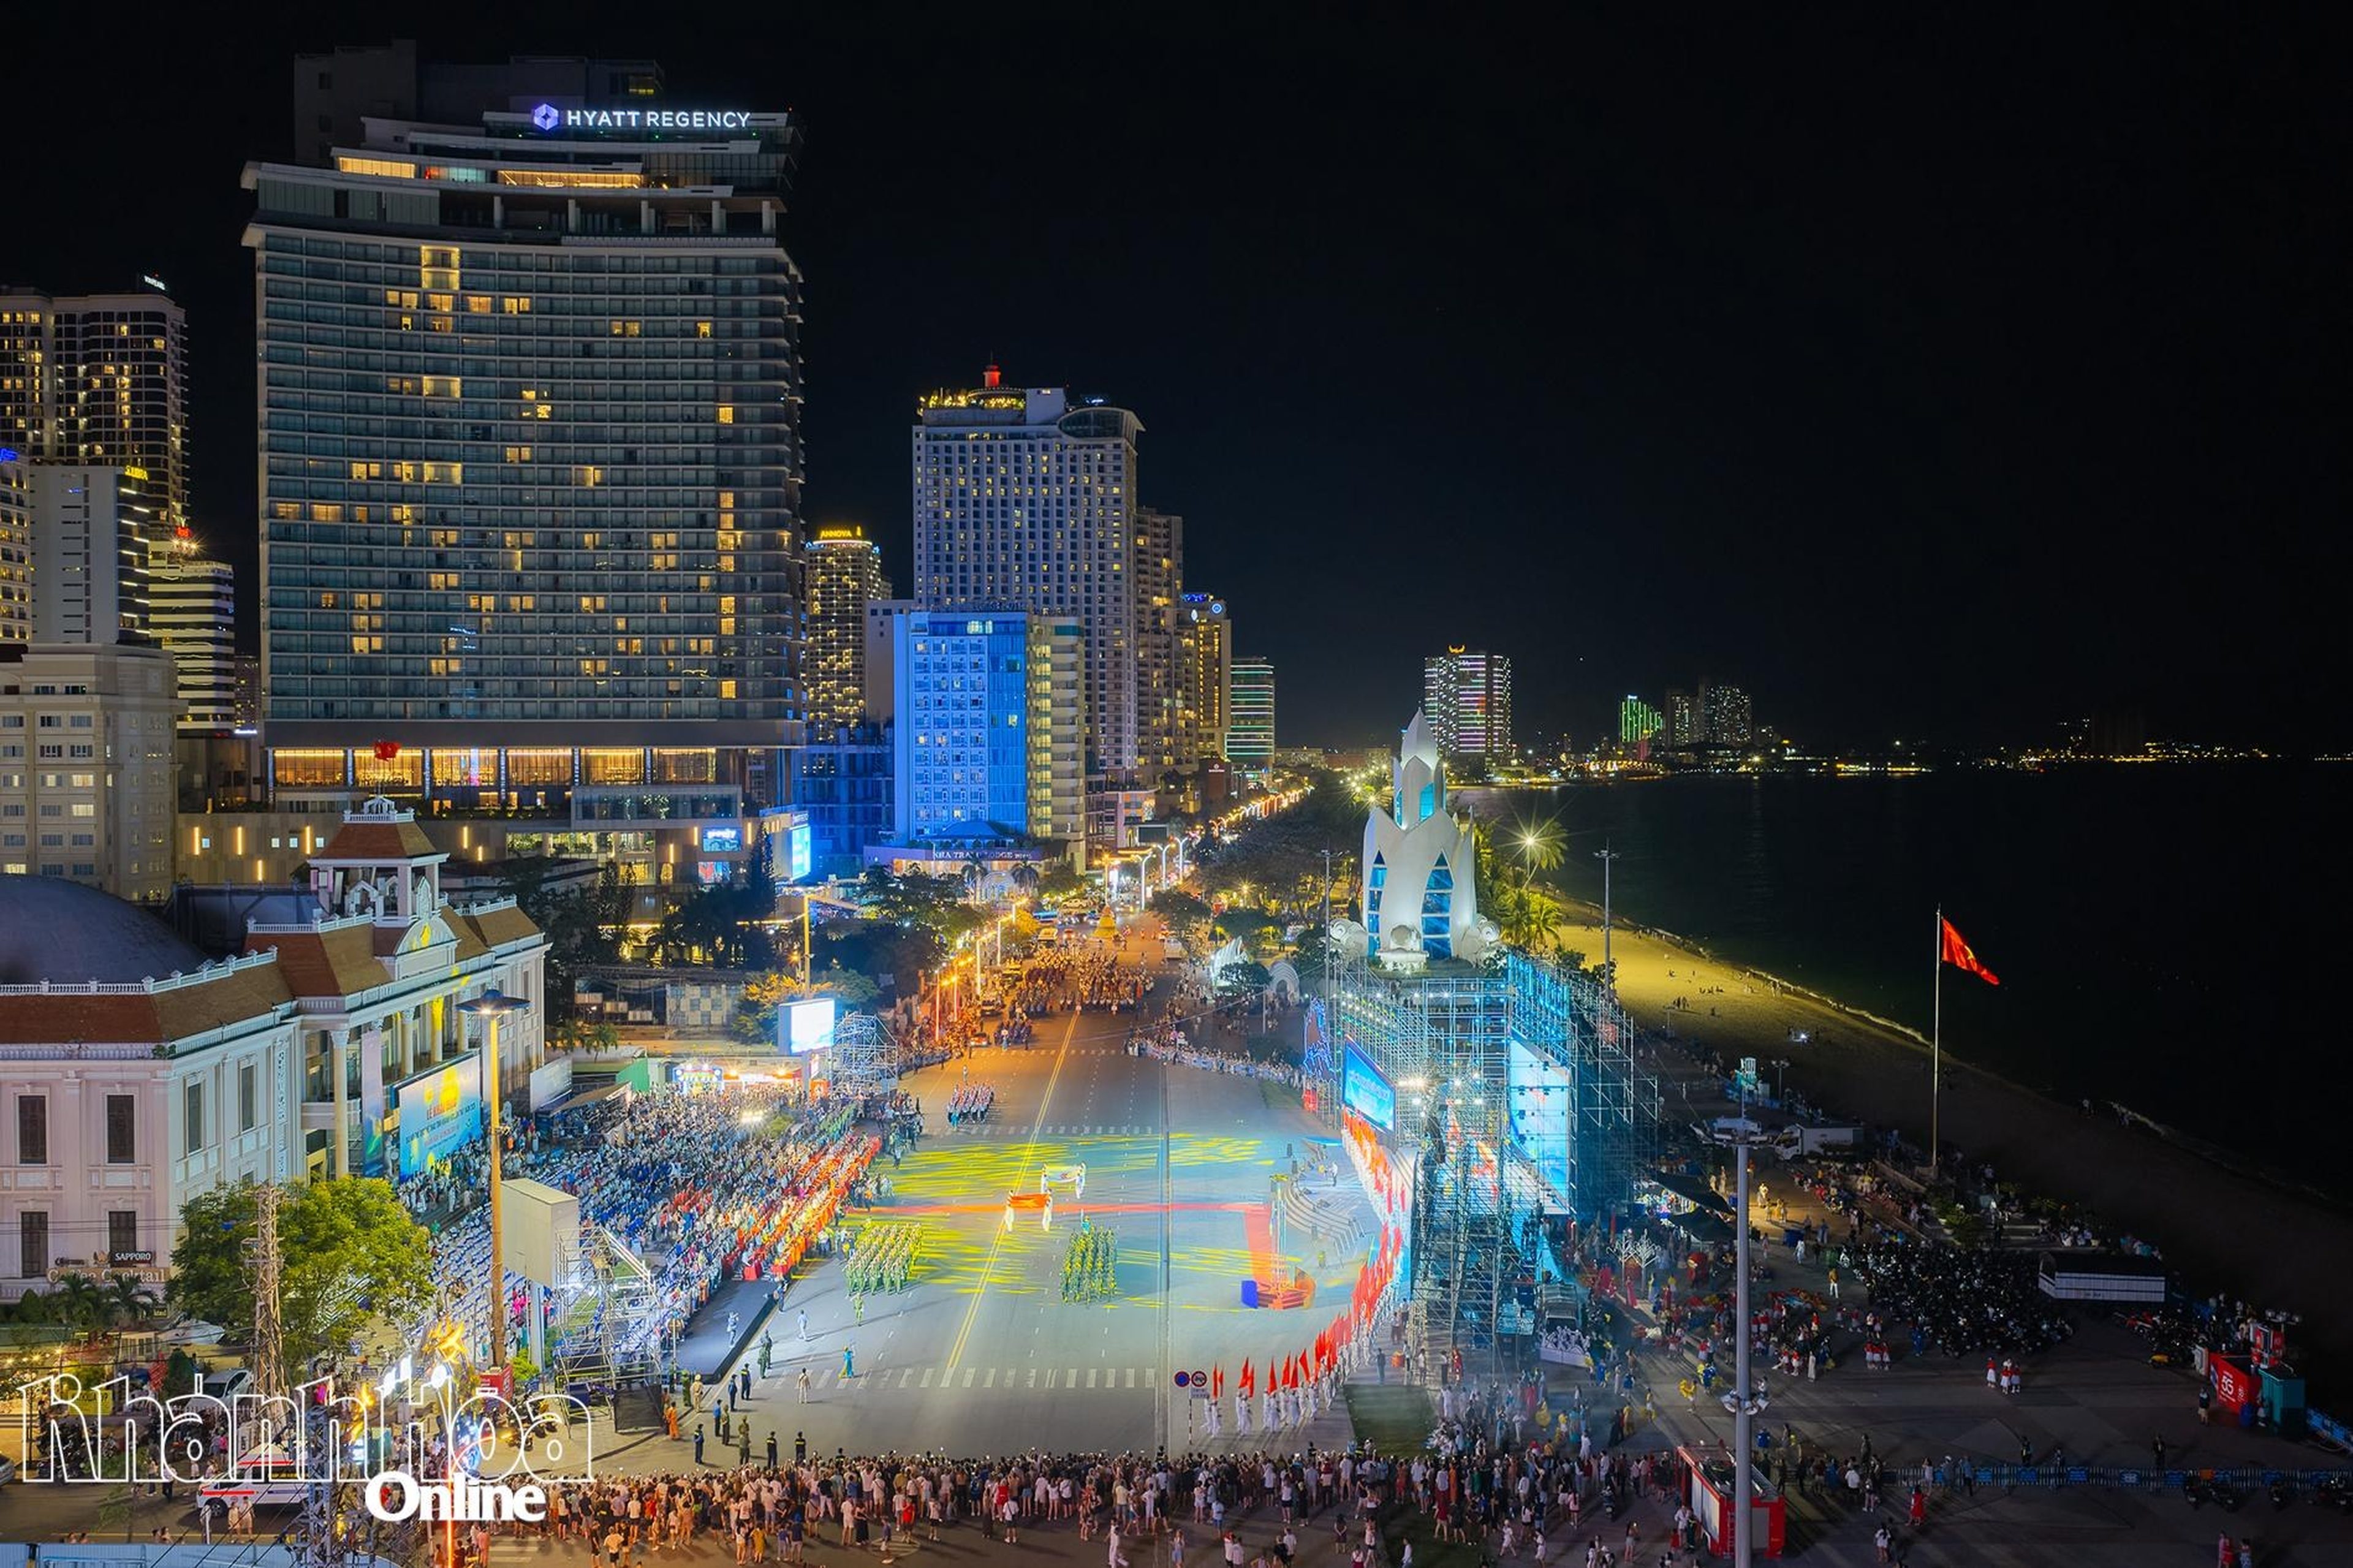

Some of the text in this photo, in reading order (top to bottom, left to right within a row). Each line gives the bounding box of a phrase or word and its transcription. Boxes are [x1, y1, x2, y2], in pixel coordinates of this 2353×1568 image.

[567, 110, 751, 128] HYATT REGENCY
[820, 529, 852, 539] ANNOVA
[115, 1252, 151, 1261] SAPPORO
[47, 1268, 165, 1283] Cffee Ccktail
